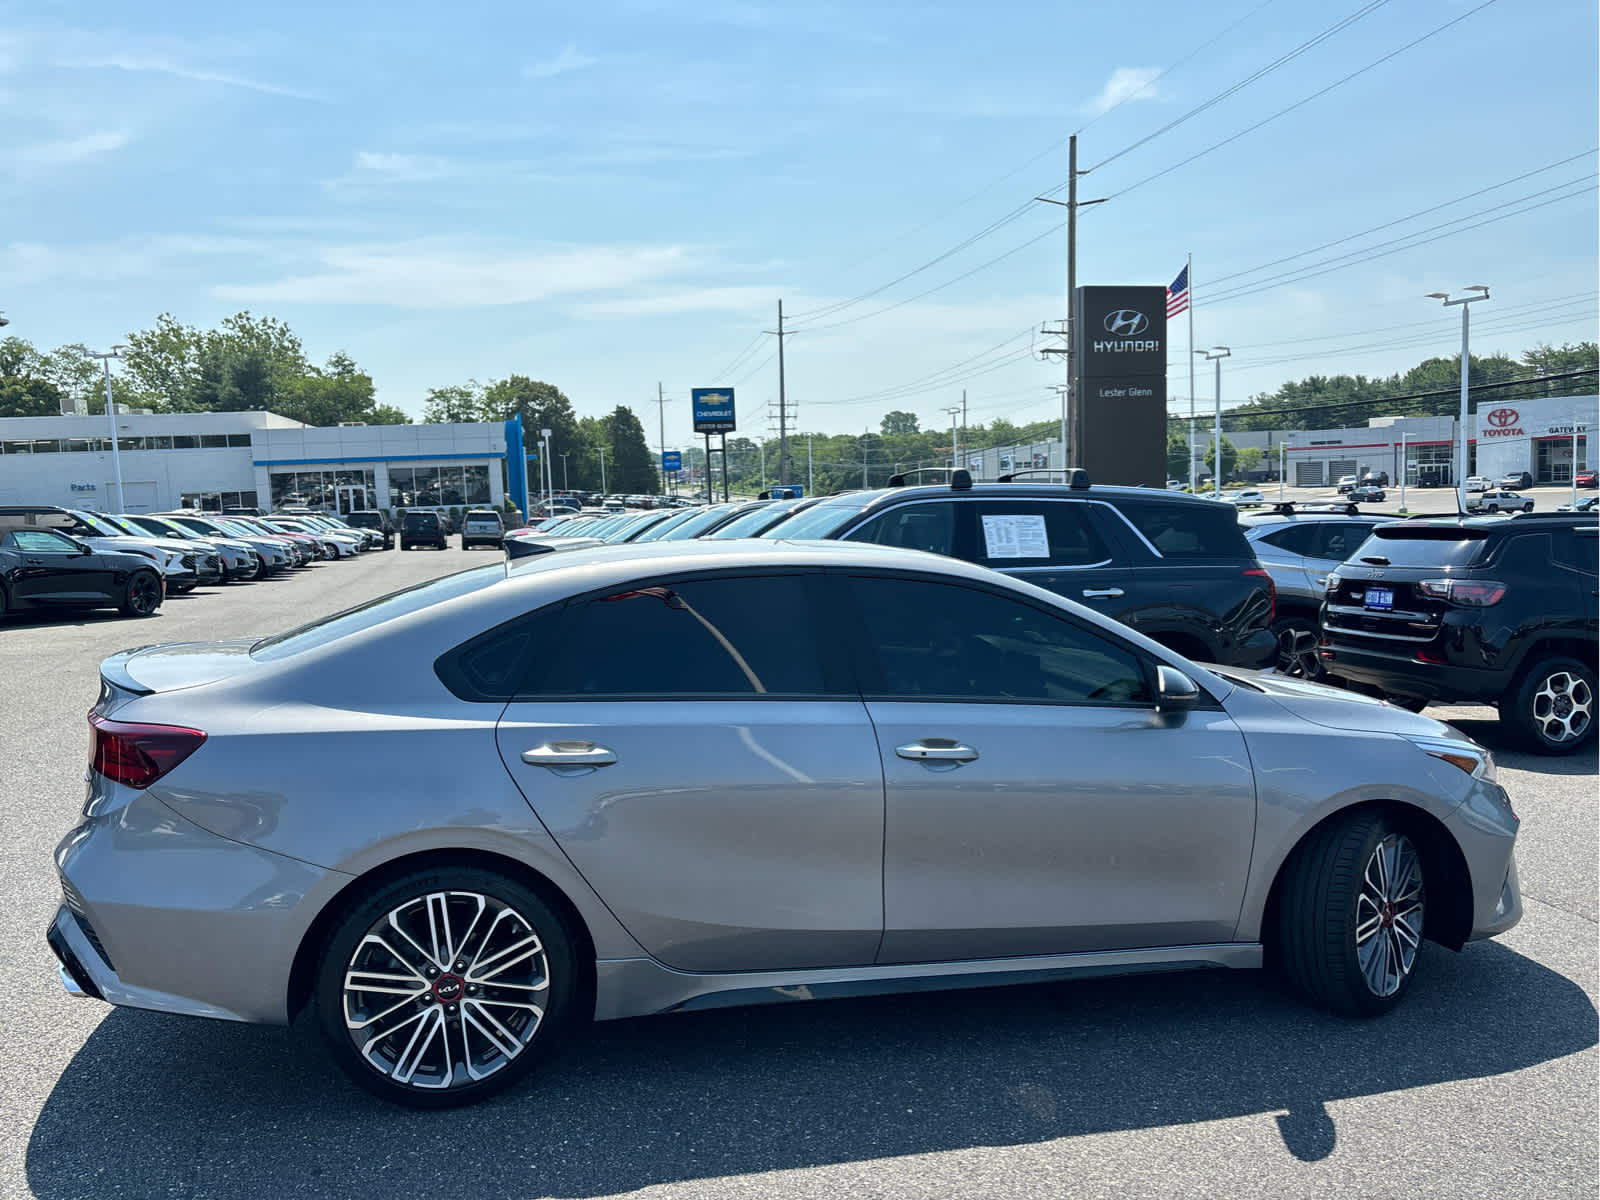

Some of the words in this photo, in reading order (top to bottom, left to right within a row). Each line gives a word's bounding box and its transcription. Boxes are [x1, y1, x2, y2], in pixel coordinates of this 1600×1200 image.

[1094, 341, 1159, 353] HYUNDAI
[1099, 387, 1126, 397] Lester
[1128, 387, 1152, 397] Glenn
[1482, 428, 1524, 437] TOYOTA
